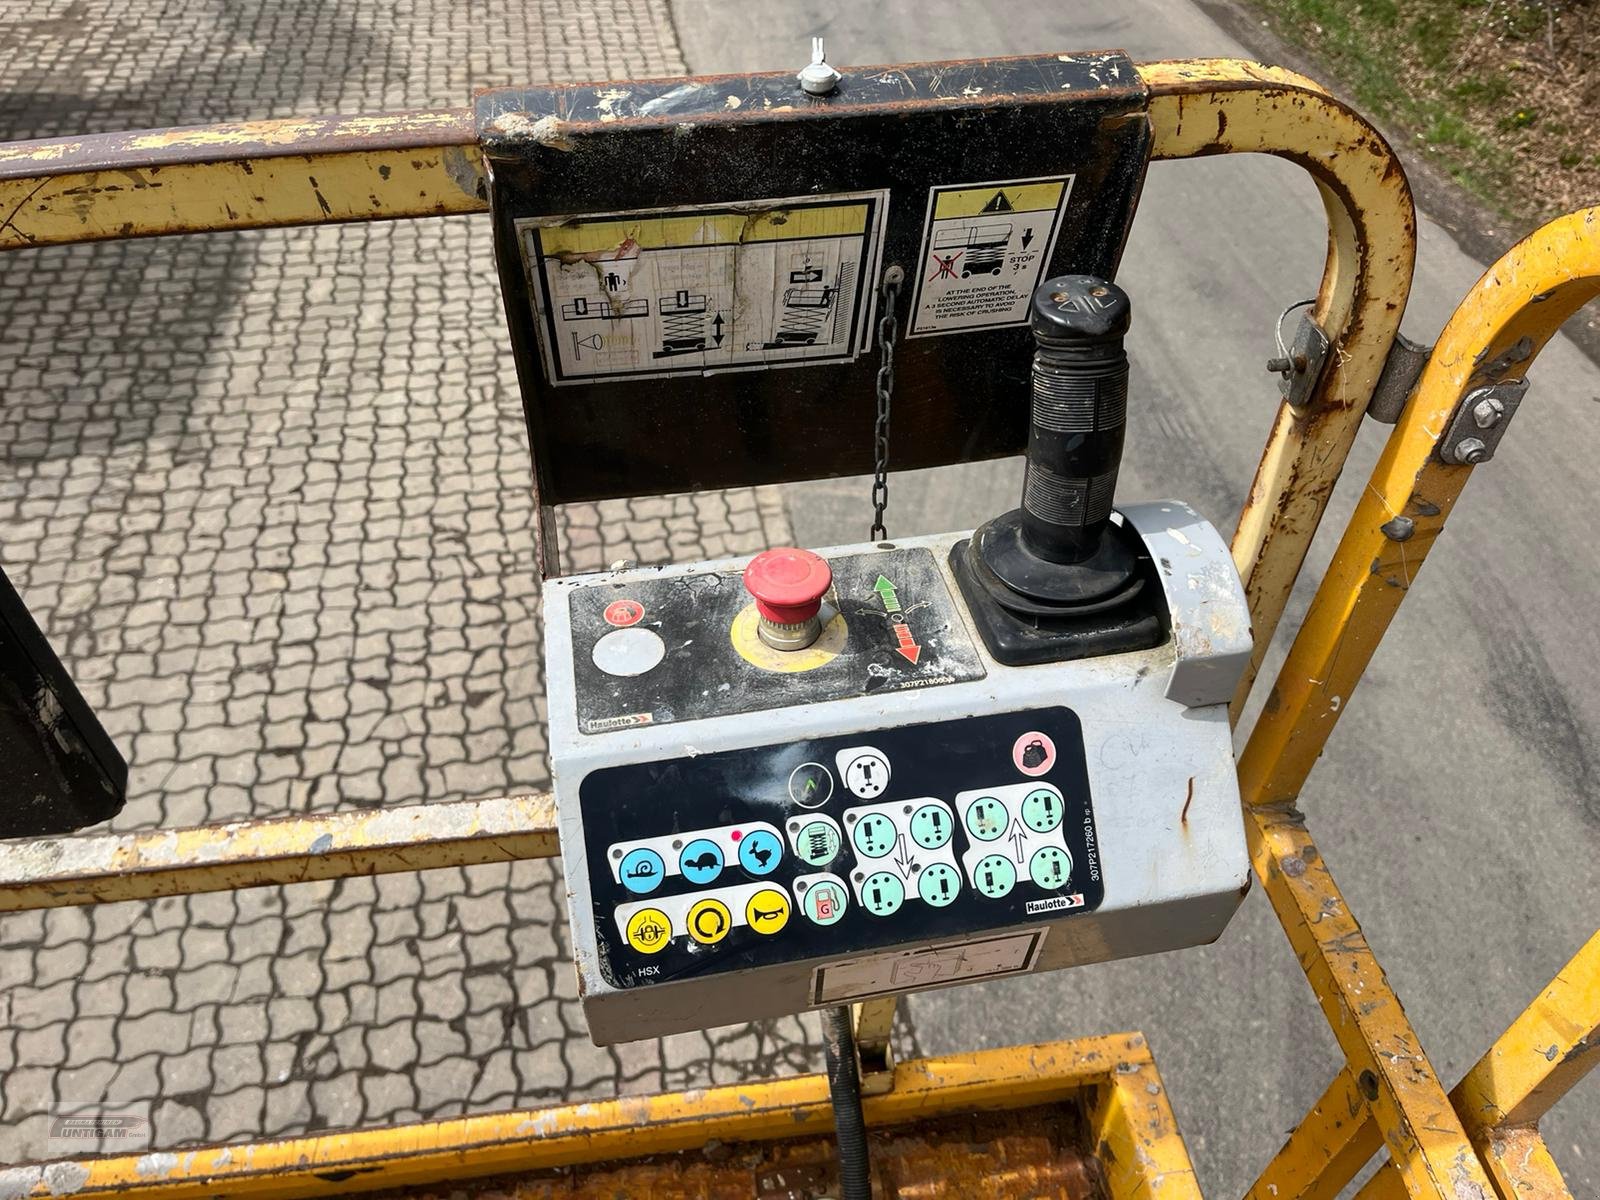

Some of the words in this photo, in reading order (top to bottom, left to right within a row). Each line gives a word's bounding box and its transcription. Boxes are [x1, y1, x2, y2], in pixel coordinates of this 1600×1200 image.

[1009, 255, 1035, 263] STOP
[1013, 263, 1020, 271] 3
[936, 300, 966, 308] SECOND
[967, 296, 1005, 305] AUTOMATIC
[1006, 293, 1029, 301] DELAY
[937, 294, 975, 302] LOWERING
[943, 304, 985, 313] NECESSARY
[977, 307, 1013, 315] CRUSHING
[590, 717, 632, 730] Haulotte
[1084, 825, 1100, 882] 307P217260
[820, 903, 830, 915] G
[1027, 898, 1067, 913] Haulotte
[637, 964, 661, 977] HSX
